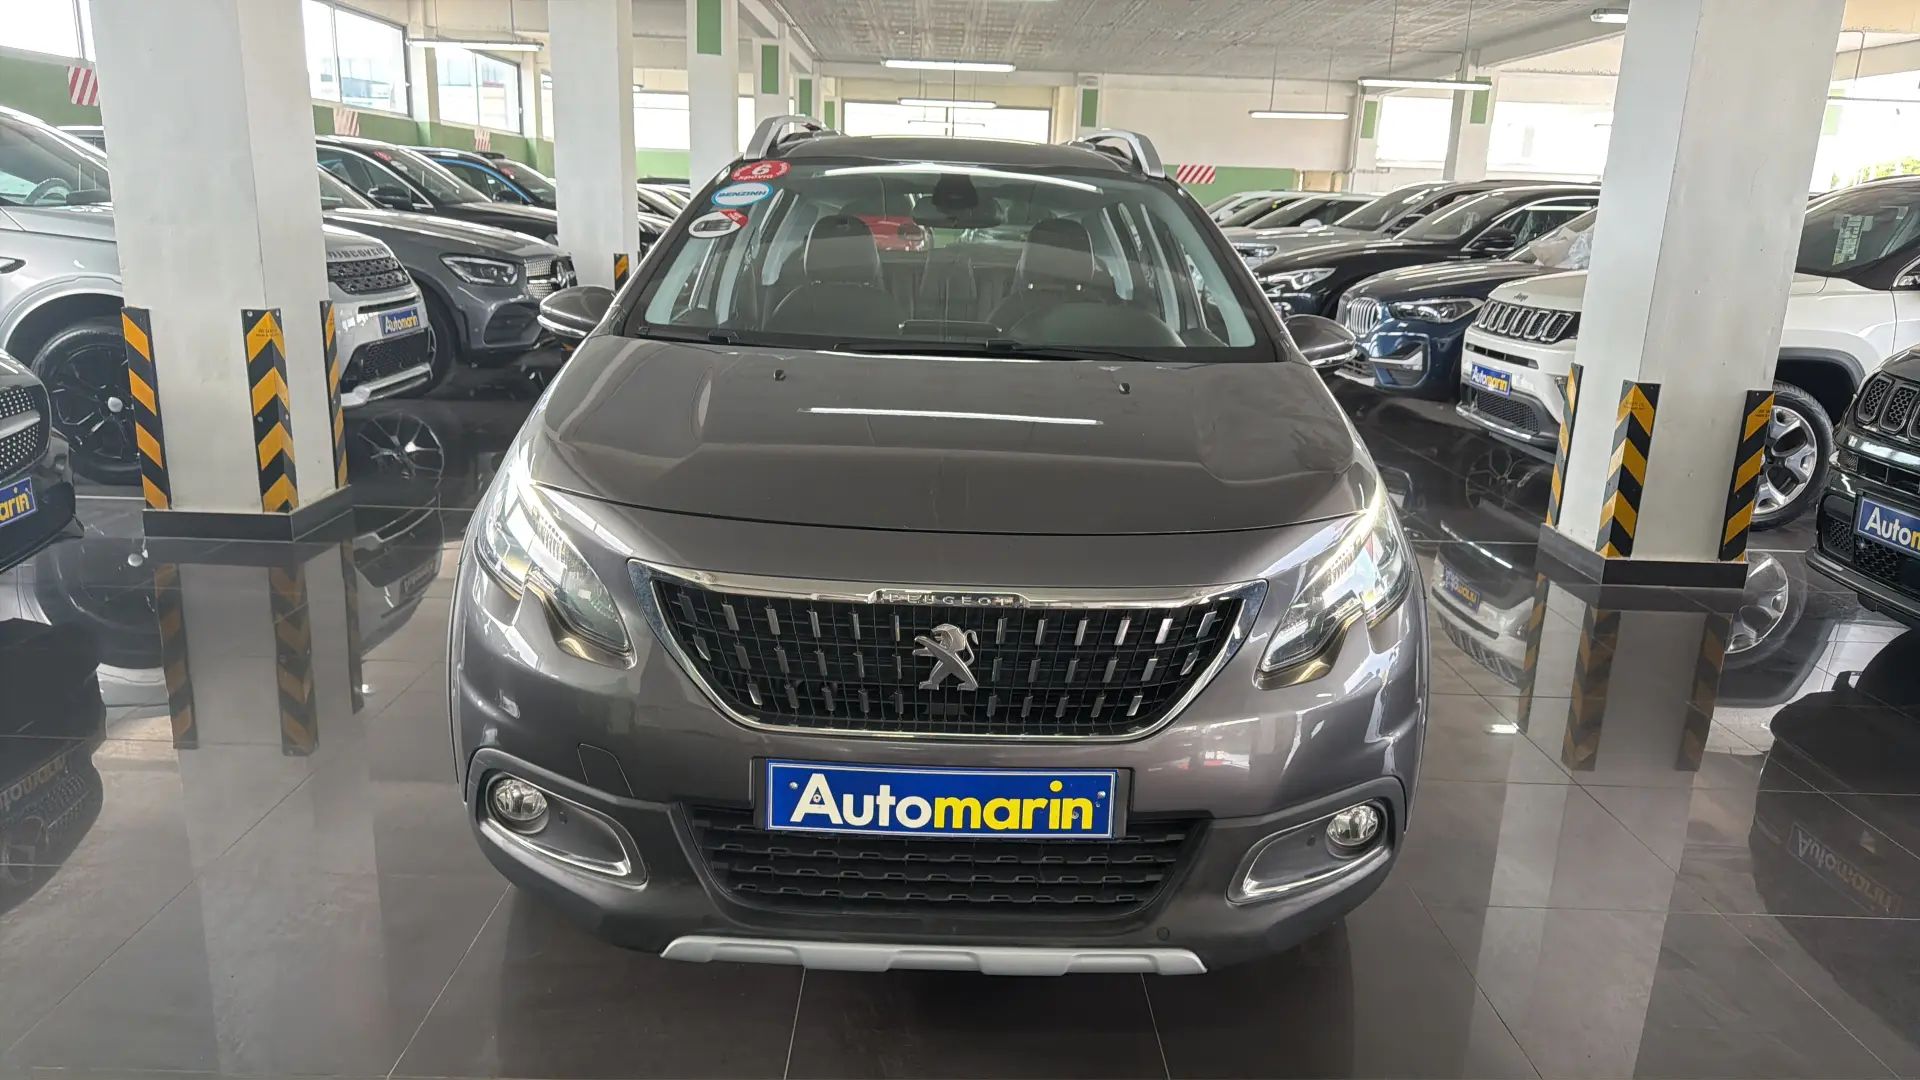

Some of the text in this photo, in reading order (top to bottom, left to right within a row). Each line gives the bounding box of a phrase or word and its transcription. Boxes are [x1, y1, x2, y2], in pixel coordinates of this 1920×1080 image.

[752, 163, 773, 175] 6
[385, 310, 419, 334] Automarin
[1472, 365, 1508, 393] Automarin
[888, 592, 1014, 606] PEUGEOT
[790, 773, 1093, 830] Automarin
